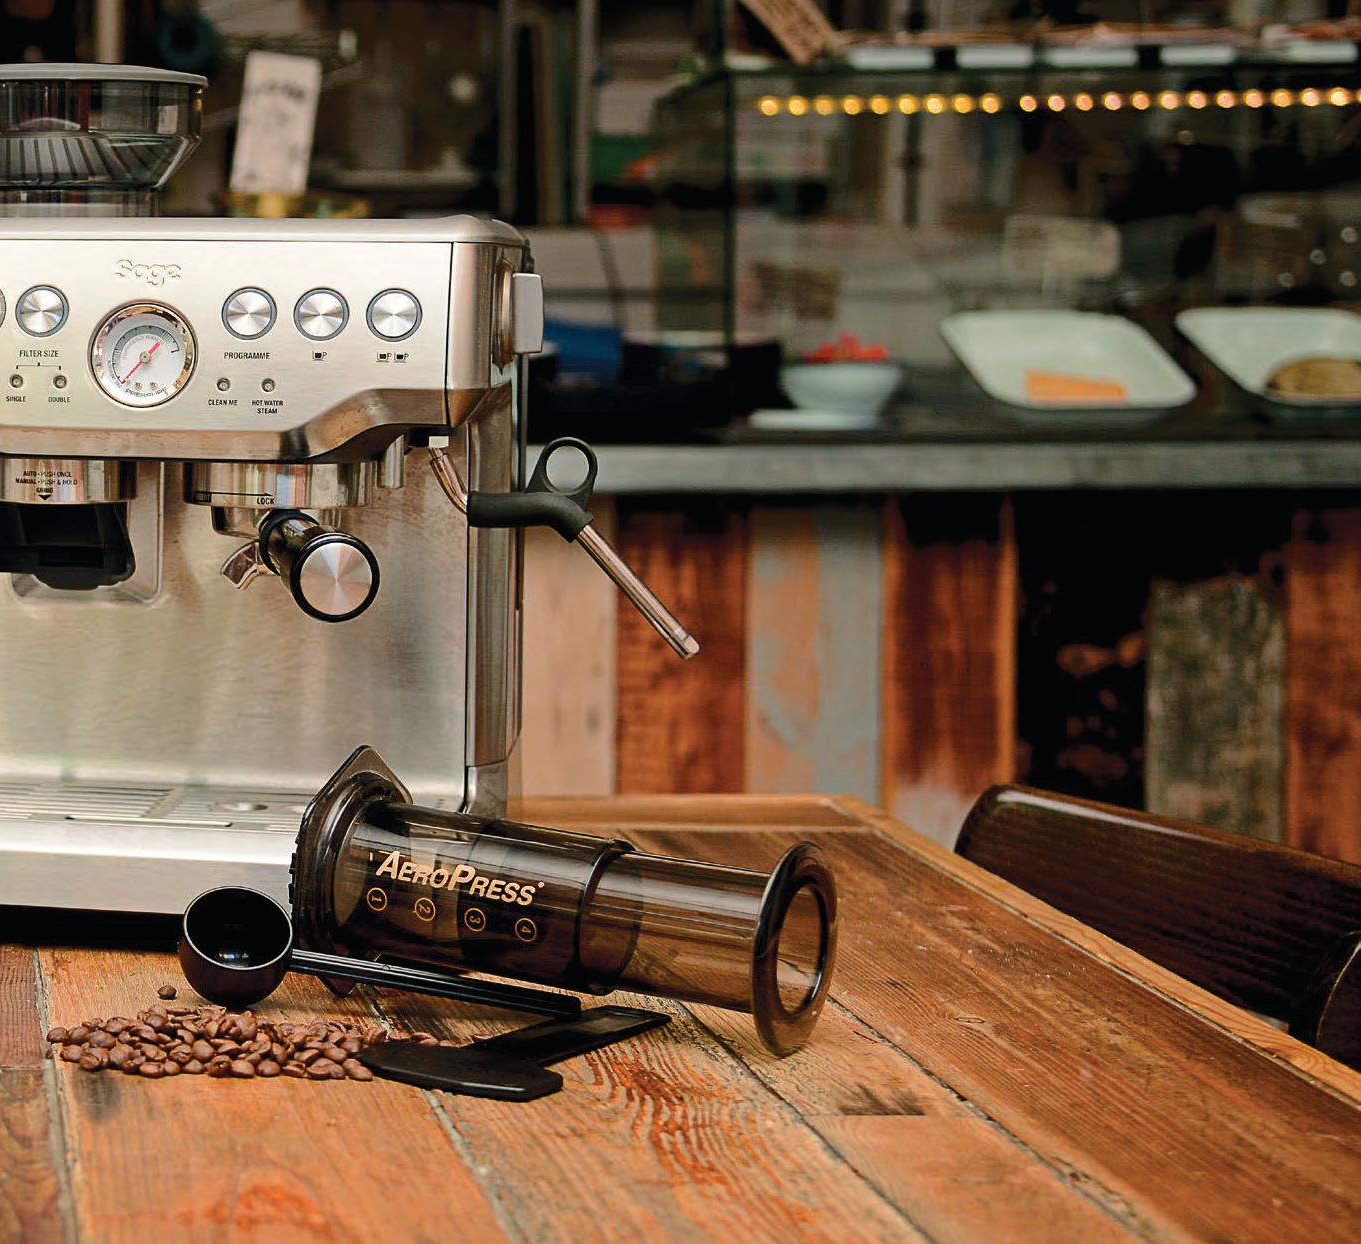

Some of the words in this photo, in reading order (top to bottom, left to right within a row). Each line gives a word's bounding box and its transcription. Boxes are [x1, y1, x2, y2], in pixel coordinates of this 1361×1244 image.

[114, 258, 182, 288] Sage
[19, 349, 42, 358] FILTER
[43, 349, 59, 358] SIZE
[223, 351, 271, 360] PROGRAMME
[5, 395, 27, 403] SINGLE
[48, 396, 71, 404] DOUBLE
[256, 497, 275, 505] LOCK
